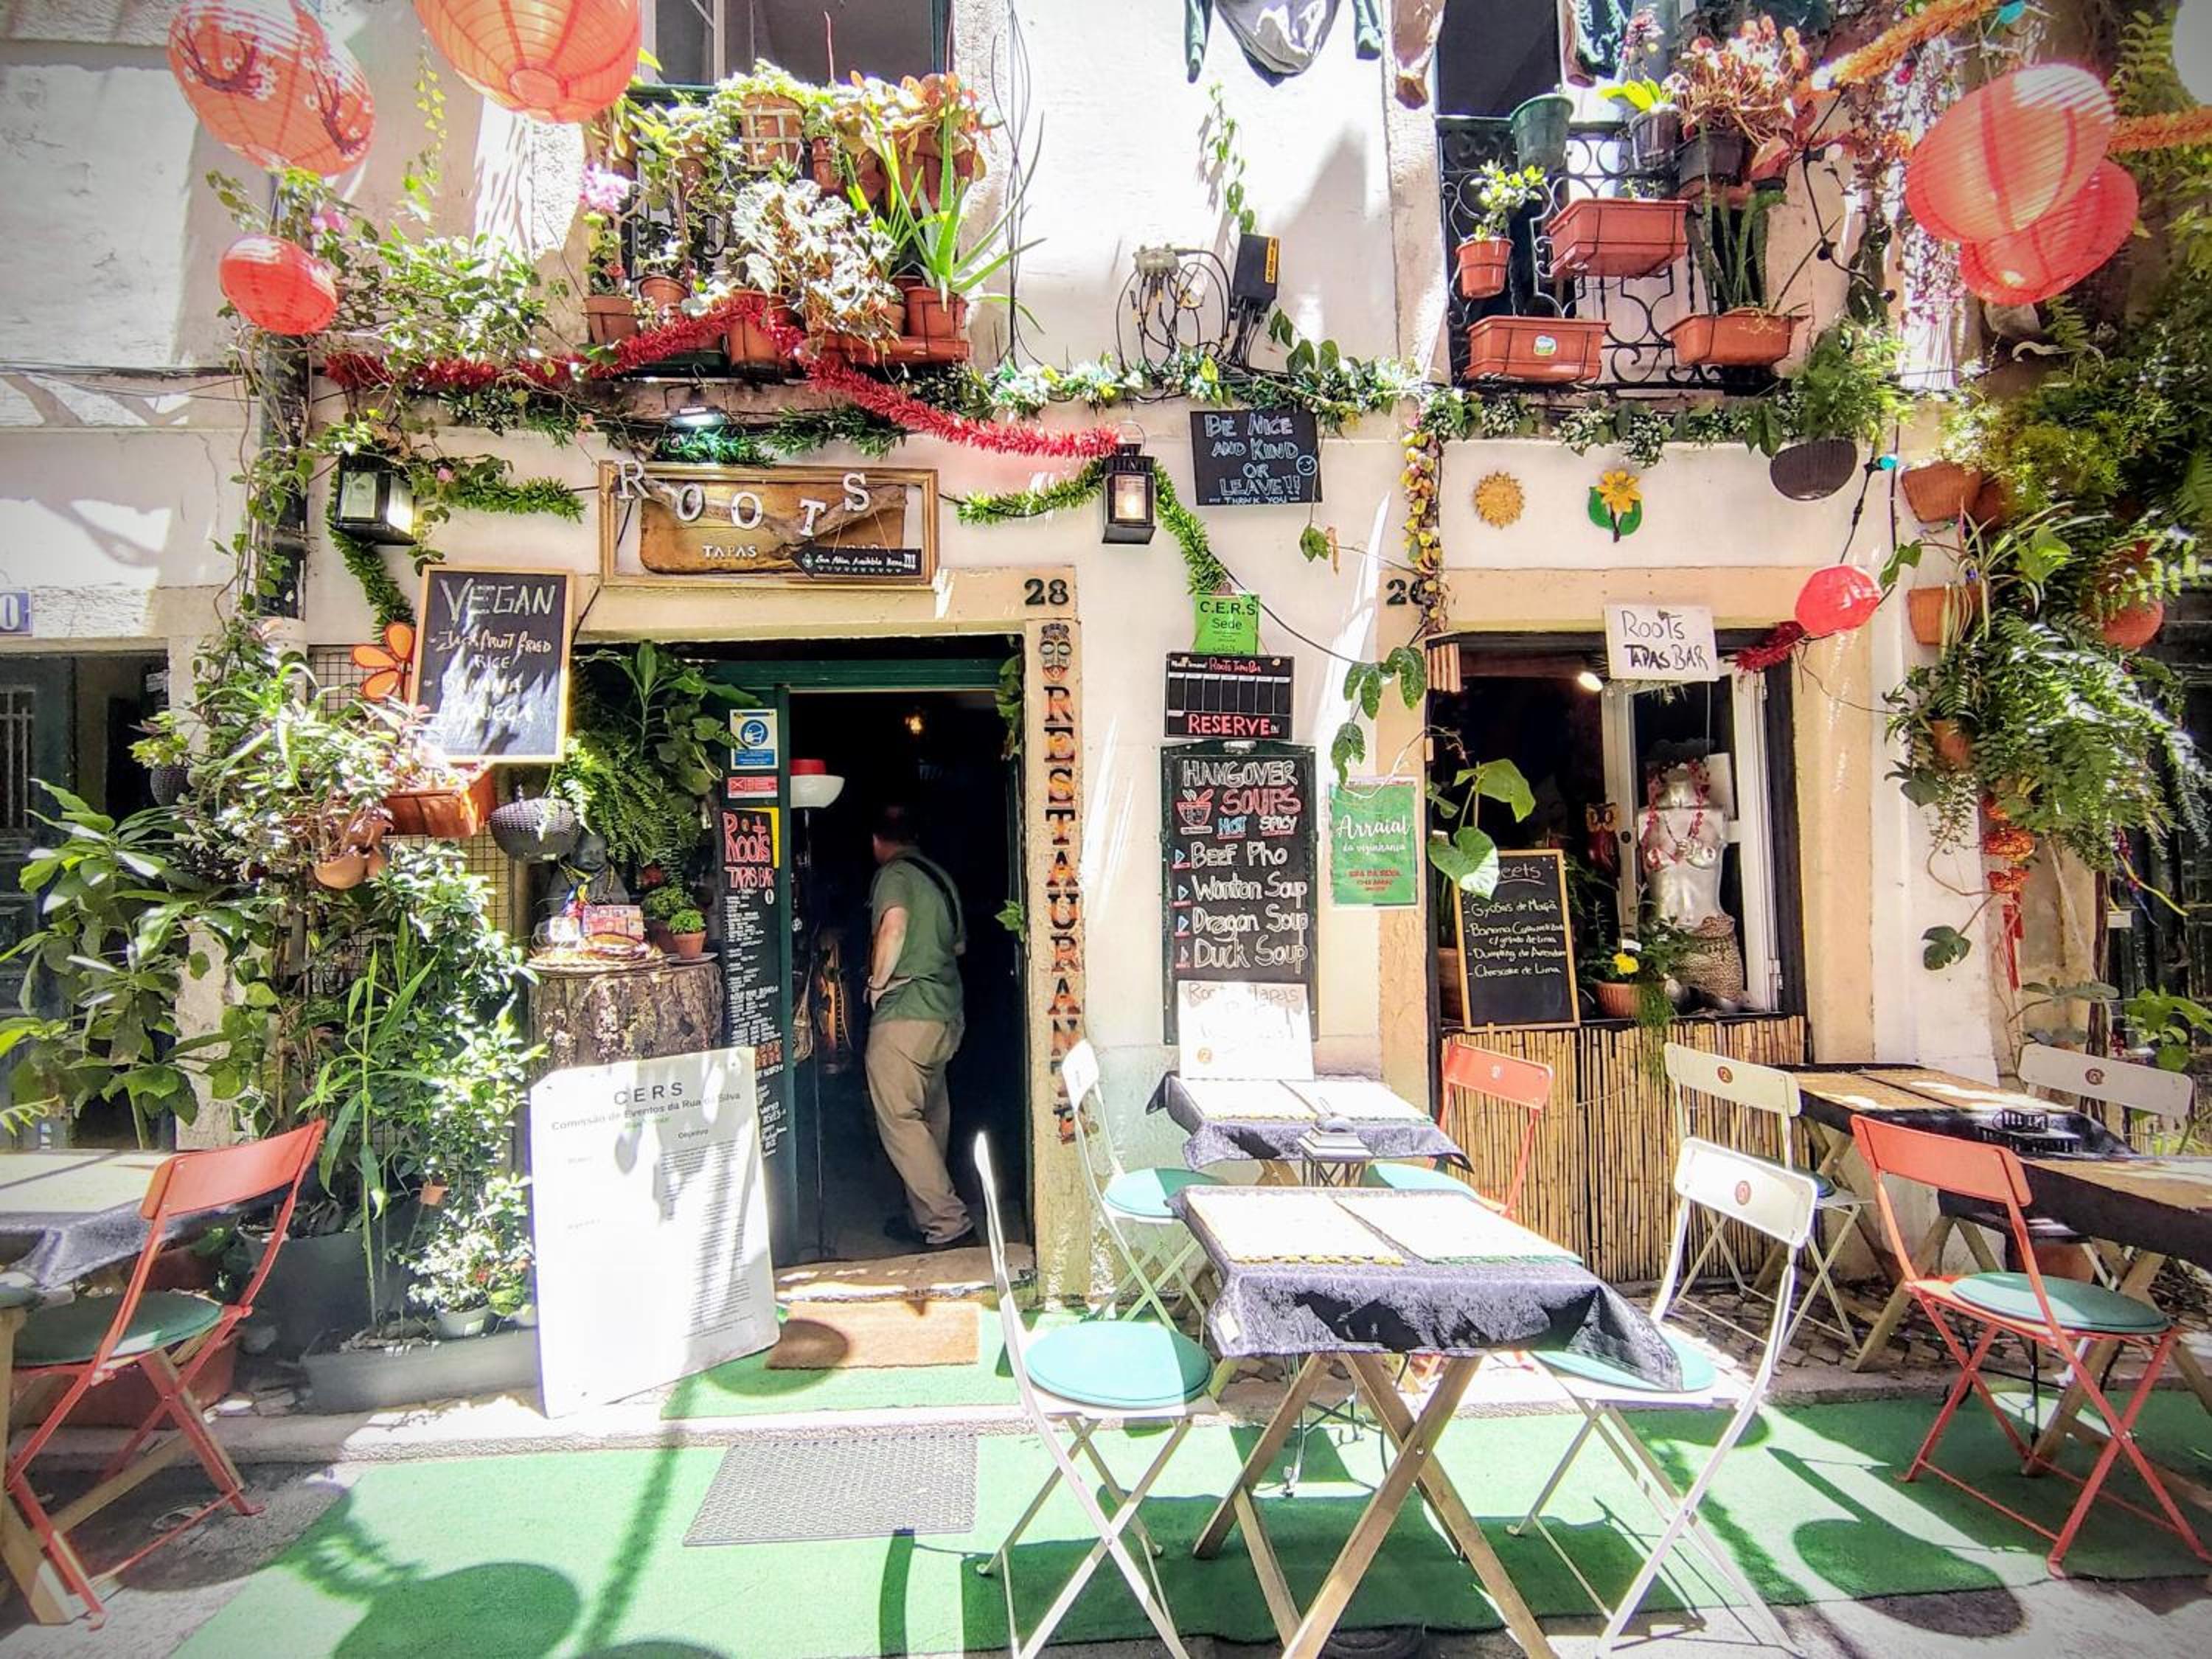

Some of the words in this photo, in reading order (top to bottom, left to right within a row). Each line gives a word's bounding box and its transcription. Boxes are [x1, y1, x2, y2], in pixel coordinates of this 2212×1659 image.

[1205, 414, 1237, 437] BE
[1248, 412, 1293, 436] NICE
[1211, 442, 1246, 457] AND
[1250, 438, 1298, 460] KIND
[1242, 462, 1270, 479] OR
[616, 462, 871, 536] ROOTS
[703, 545, 758, 558] TAPAS
[440, 578, 556, 623] VEGAN
[1024, 579, 1068, 606] 28
[1212, 617, 1242, 630] Sede
[473, 654, 510, 668] RICE
[1624, 644, 1671, 670] TAPAS
[1672, 644, 1708, 671] BAR
[1188, 714, 1270, 736] RESERVE
[1183, 760, 1298, 787] HANGOVER
[1220, 786, 1301, 816] SOUPS
[1259, 815, 1298, 832] SPICY
[1335, 815, 1410, 840] Arraial
[1247, 841, 1287, 866] Pho
[1500, 863, 1542, 879] eets
[1265, 872, 1307, 909] Soup
[1193, 907, 1259, 942] Dragon
[1265, 904, 1309, 945] Soup
[1470, 922, 1511, 936] Banana
[1194, 938, 1251, 968] Duck
[1255, 935, 1308, 974] Soup
[1534, 963, 1561, 974] Lima
[614, 1082, 683, 1105] CERS
[625, 1105, 665, 1119] Eventos
[682, 1098, 701, 1108] Rua
[718, 1091, 741, 1103] Silva
